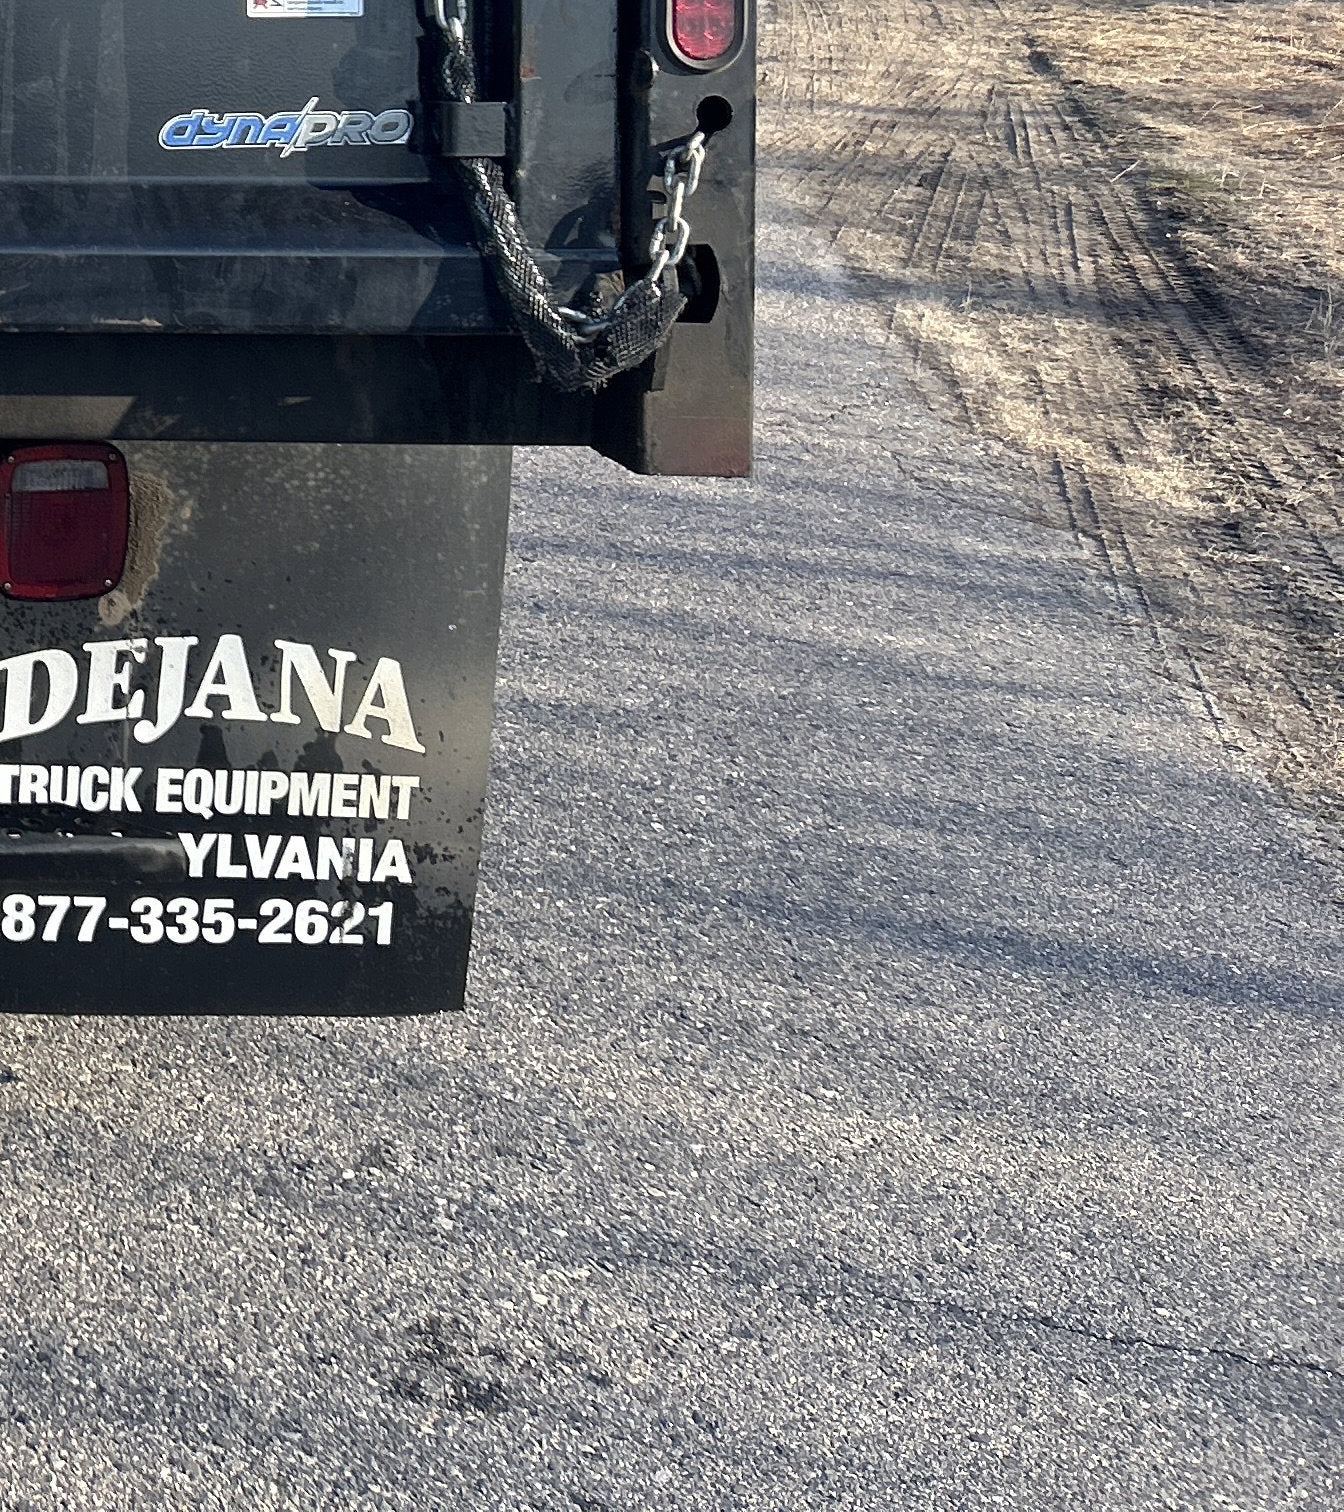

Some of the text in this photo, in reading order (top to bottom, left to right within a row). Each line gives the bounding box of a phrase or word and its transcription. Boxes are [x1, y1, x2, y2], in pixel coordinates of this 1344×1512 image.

[155, 767, 421, 820] EQUIPMENT
[176, 832, 413, 884] YLVANIA
[1, 893, 394, 946] 877-335-2621
